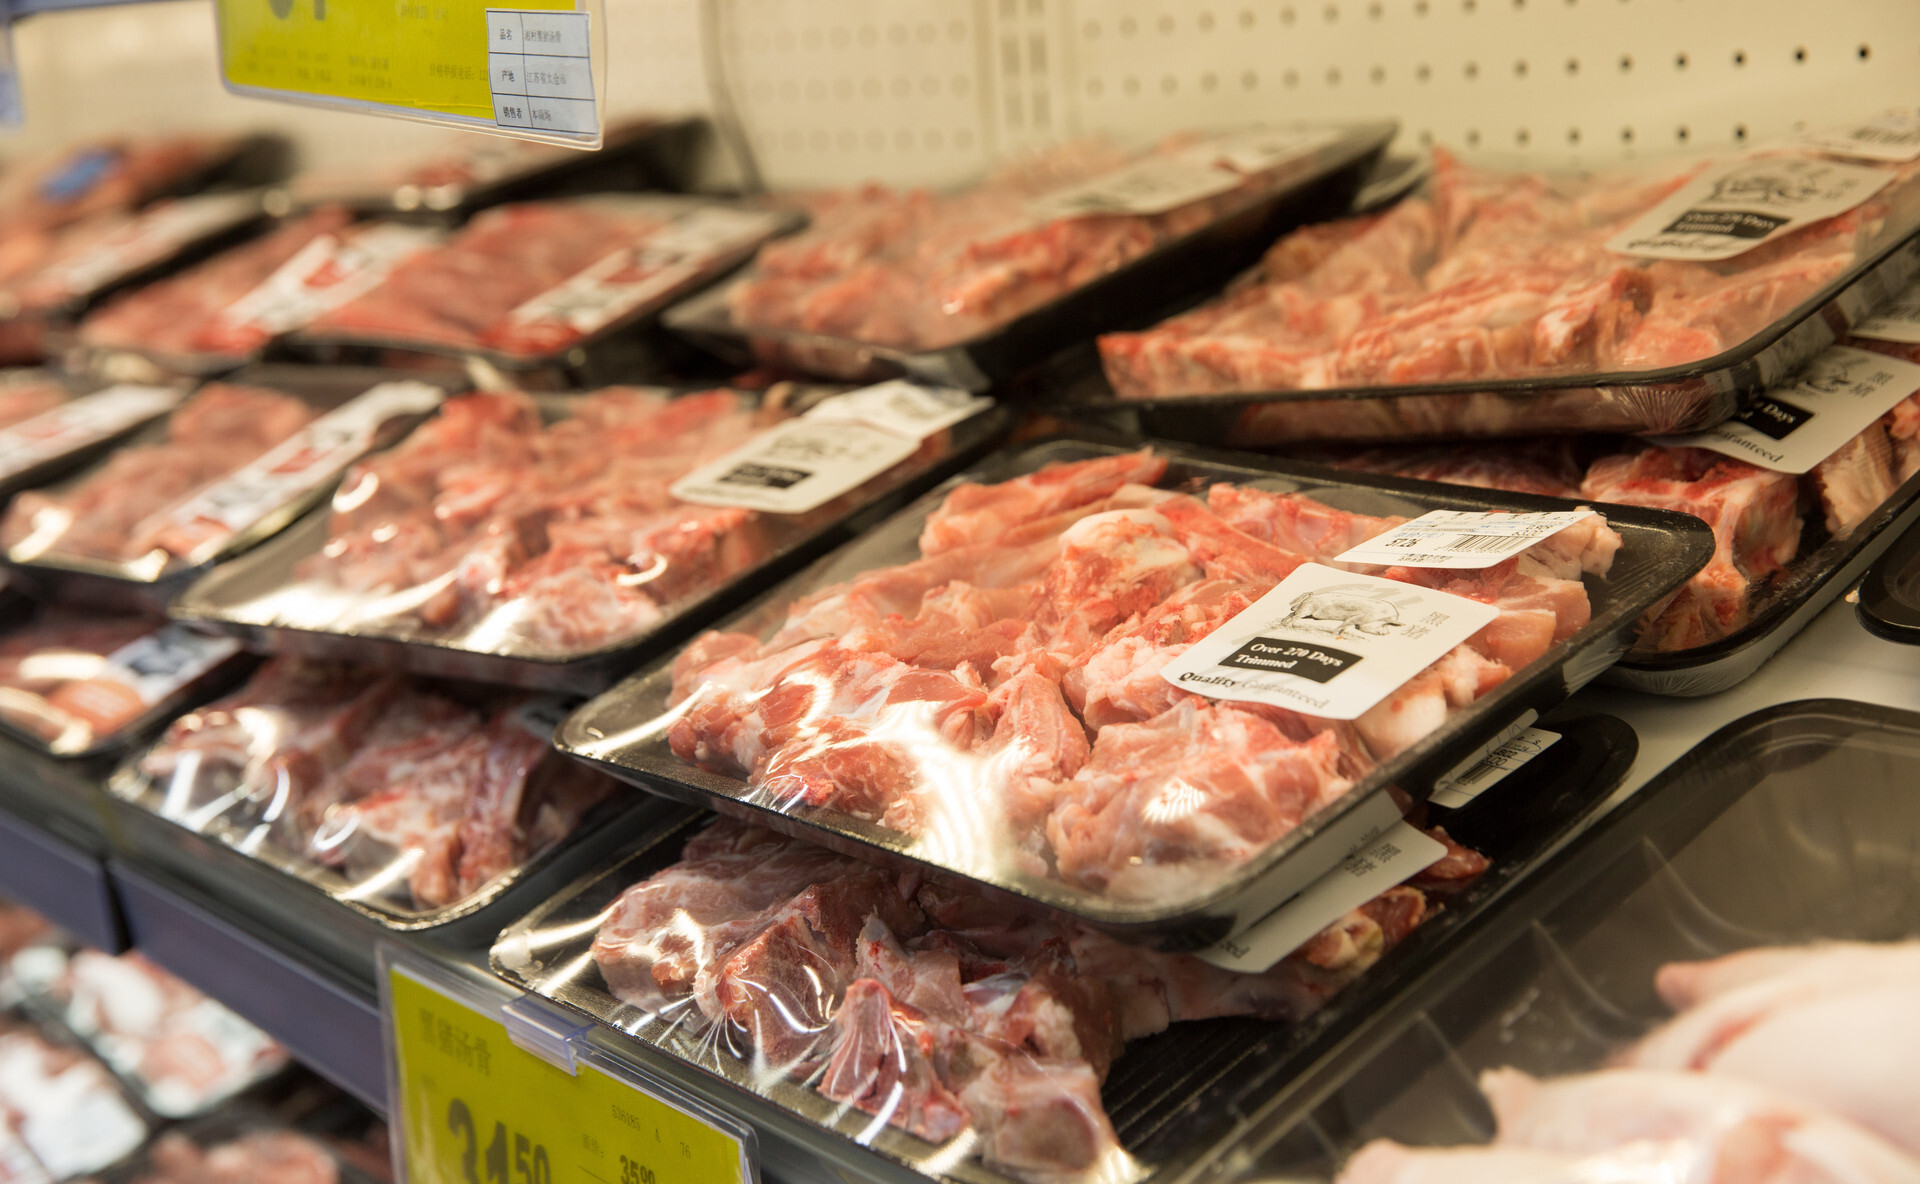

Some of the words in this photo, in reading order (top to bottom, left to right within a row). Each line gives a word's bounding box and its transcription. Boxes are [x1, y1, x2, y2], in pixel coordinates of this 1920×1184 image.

[499, 28, 513, 41] 品名
[501, 69, 515, 82] 产地
[502, 105, 523, 119] 销售者
[1234, 653, 1299, 670] Trimmed
[1249, 642, 1285, 655] Over
[1284, 646, 1309, 659] 270
[1307, 650, 1344, 668] Days
[1177, 671, 1243, 689] Quality
